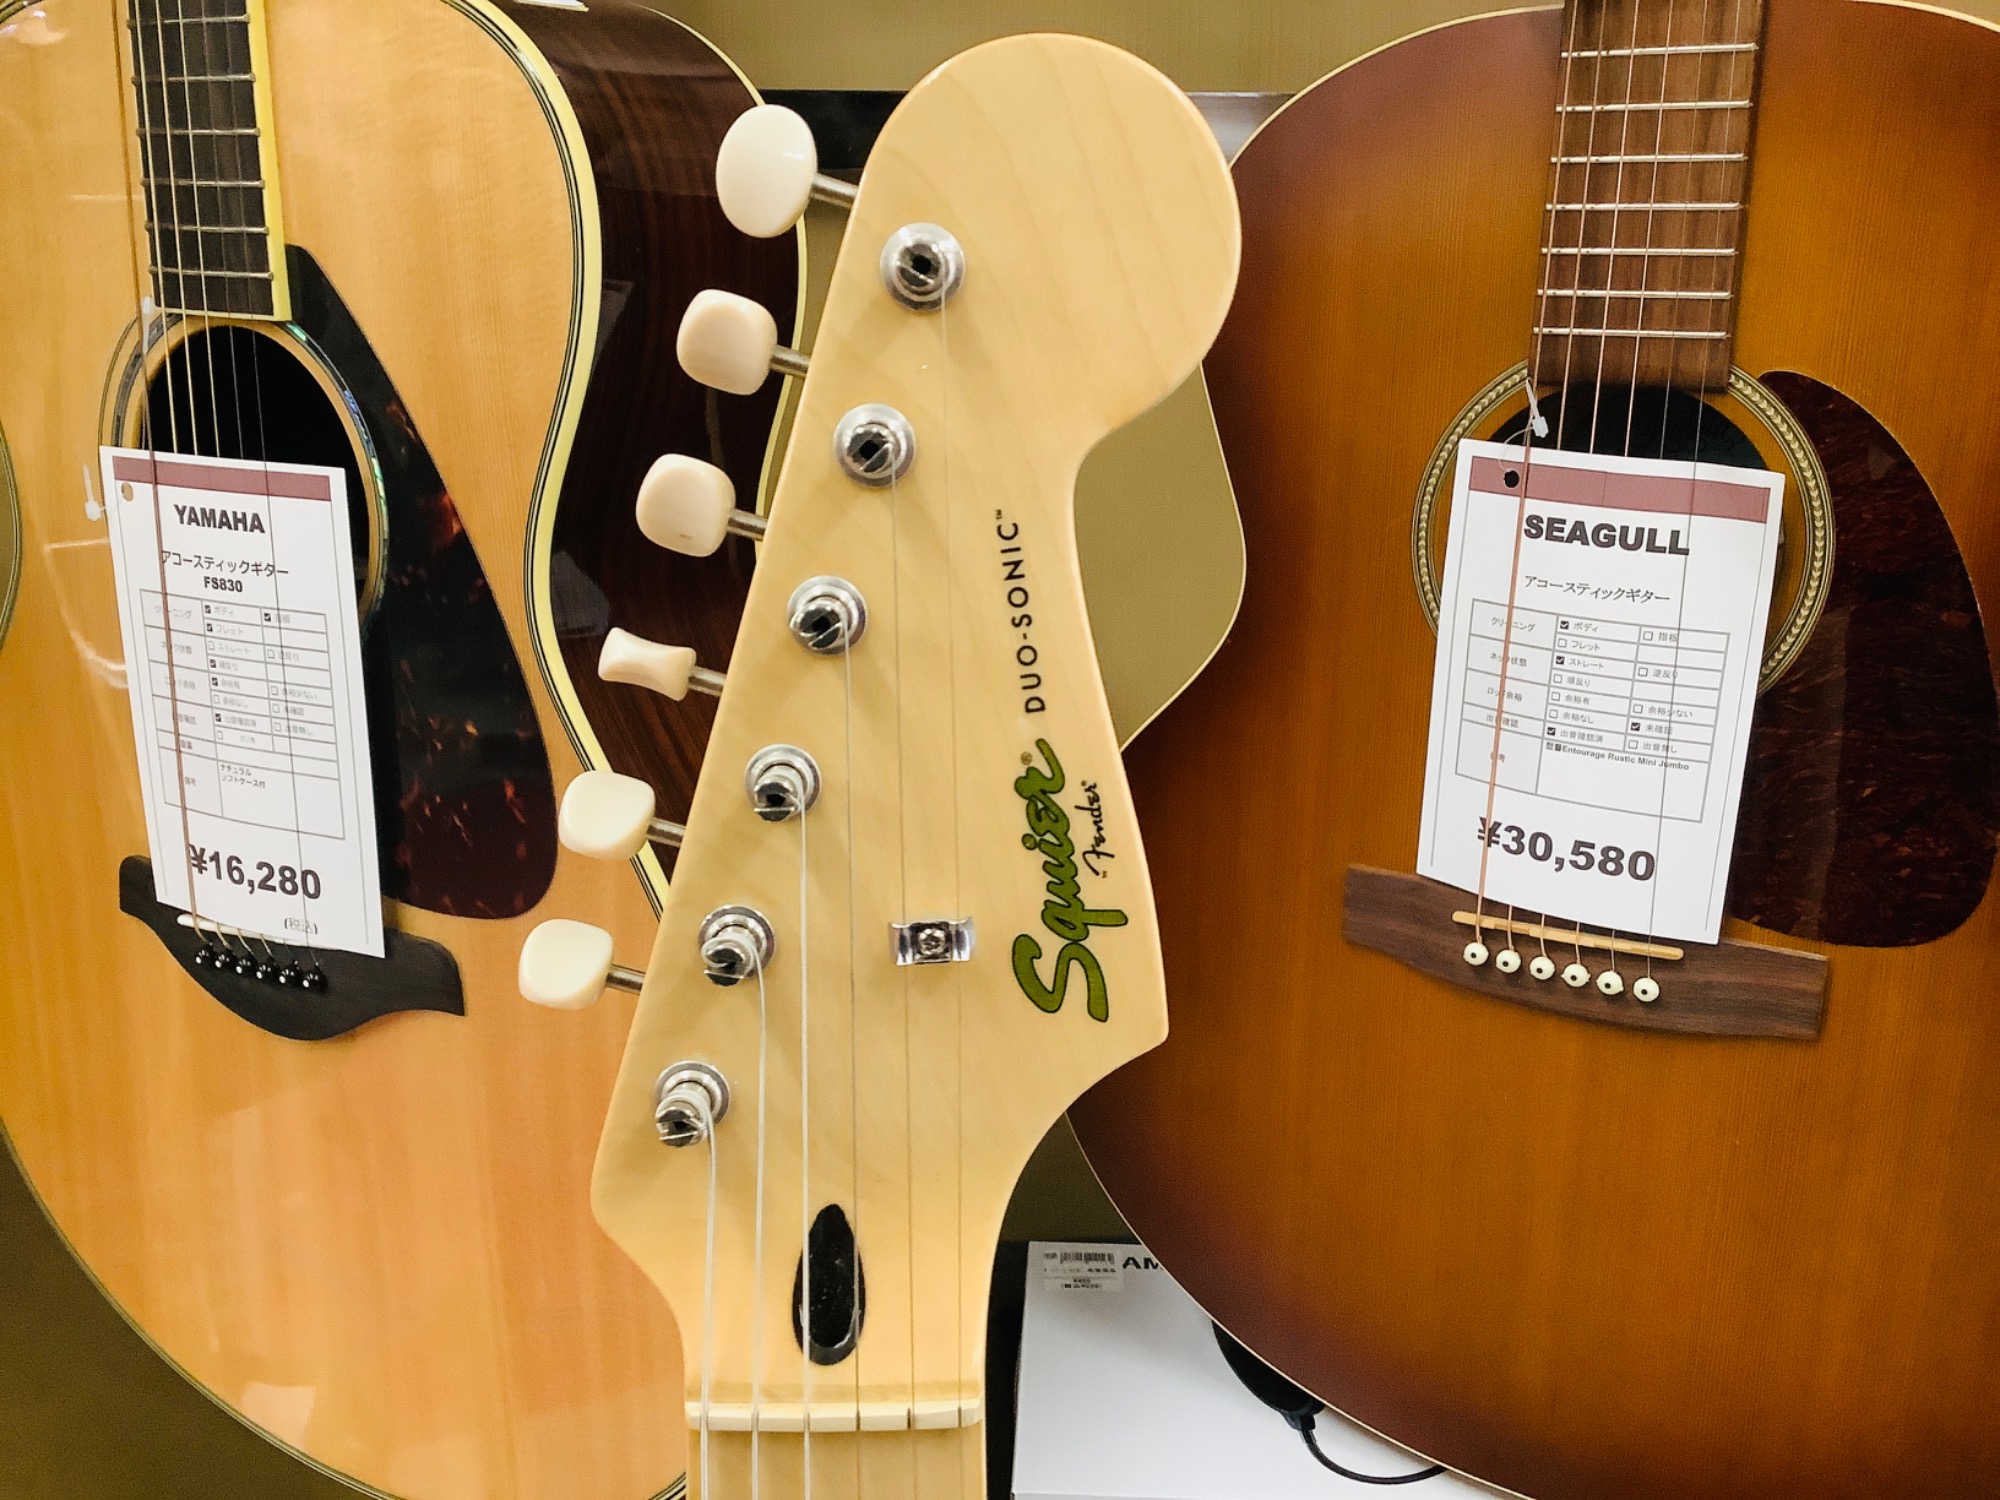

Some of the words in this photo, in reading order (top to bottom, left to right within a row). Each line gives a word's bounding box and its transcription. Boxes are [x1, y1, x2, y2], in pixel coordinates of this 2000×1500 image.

[174, 504, 265, 534] YAMAHA
[1524, 515, 1690, 556] SEAGULL
[161, 550, 289, 577] アコースティックギター
[203, 576, 244, 592] FS830
[1525, 575, 1671, 603] アコースティックギター
[1573, 621, 1600, 633] ボディ
[1571, 640, 1600, 651] フレット
[1569, 658, 1605, 669] ストレート
[1607, 752, 1636, 765] Rustic
[1638, 756, 1657, 767] Mini
[1658, 759, 1690, 771] Jumbo
[1074, 782, 1115, 876] Fender
[1477, 816, 1656, 881] ¥30,580
[188, 843, 322, 899] ¥16,280
[1012, 738, 1128, 1022] Squier
